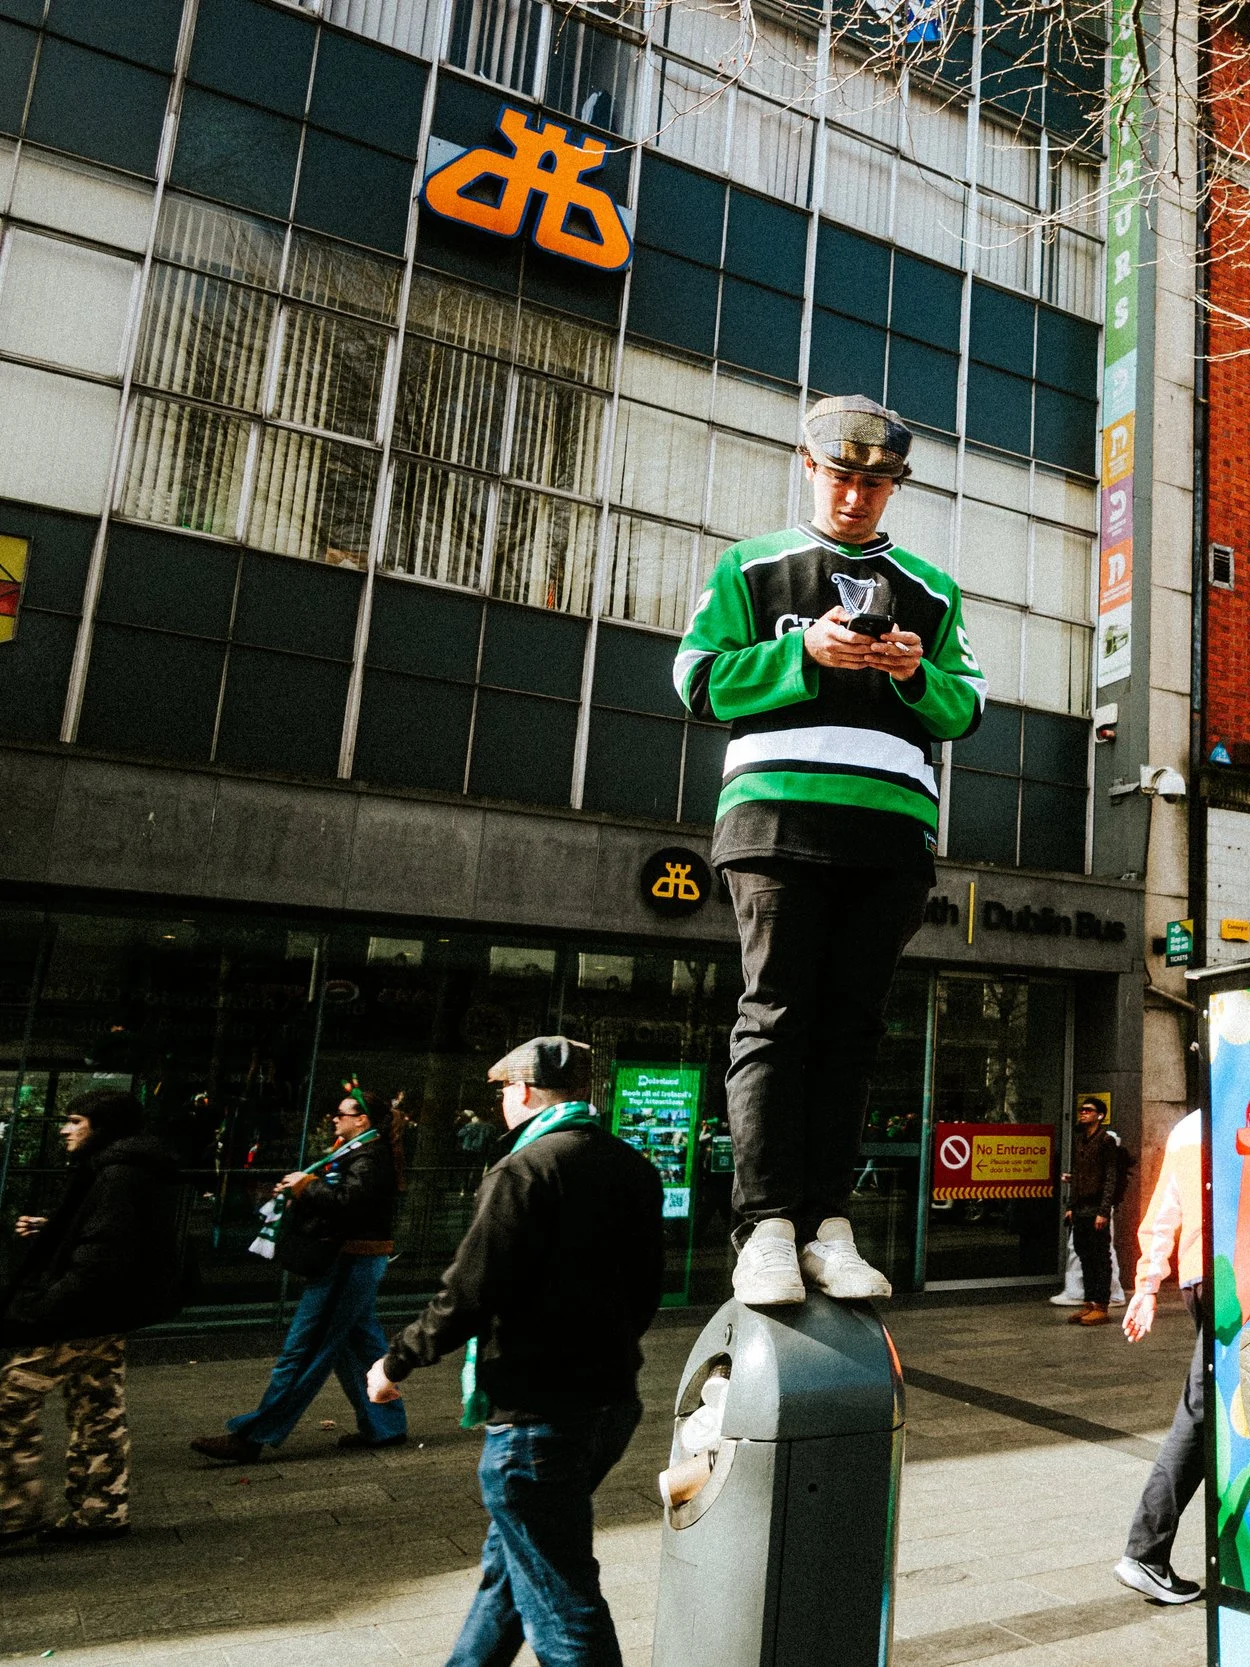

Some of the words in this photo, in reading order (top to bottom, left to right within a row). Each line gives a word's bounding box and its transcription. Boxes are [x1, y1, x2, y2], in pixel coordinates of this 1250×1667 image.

[982, 900, 1072, 936] Dublin
[1075, 911, 1127, 941] Bus
[629, 1097, 643, 1106] Top
[976, 1144, 993, 1155] No
[996, 1144, 1047, 1156] Entrance
